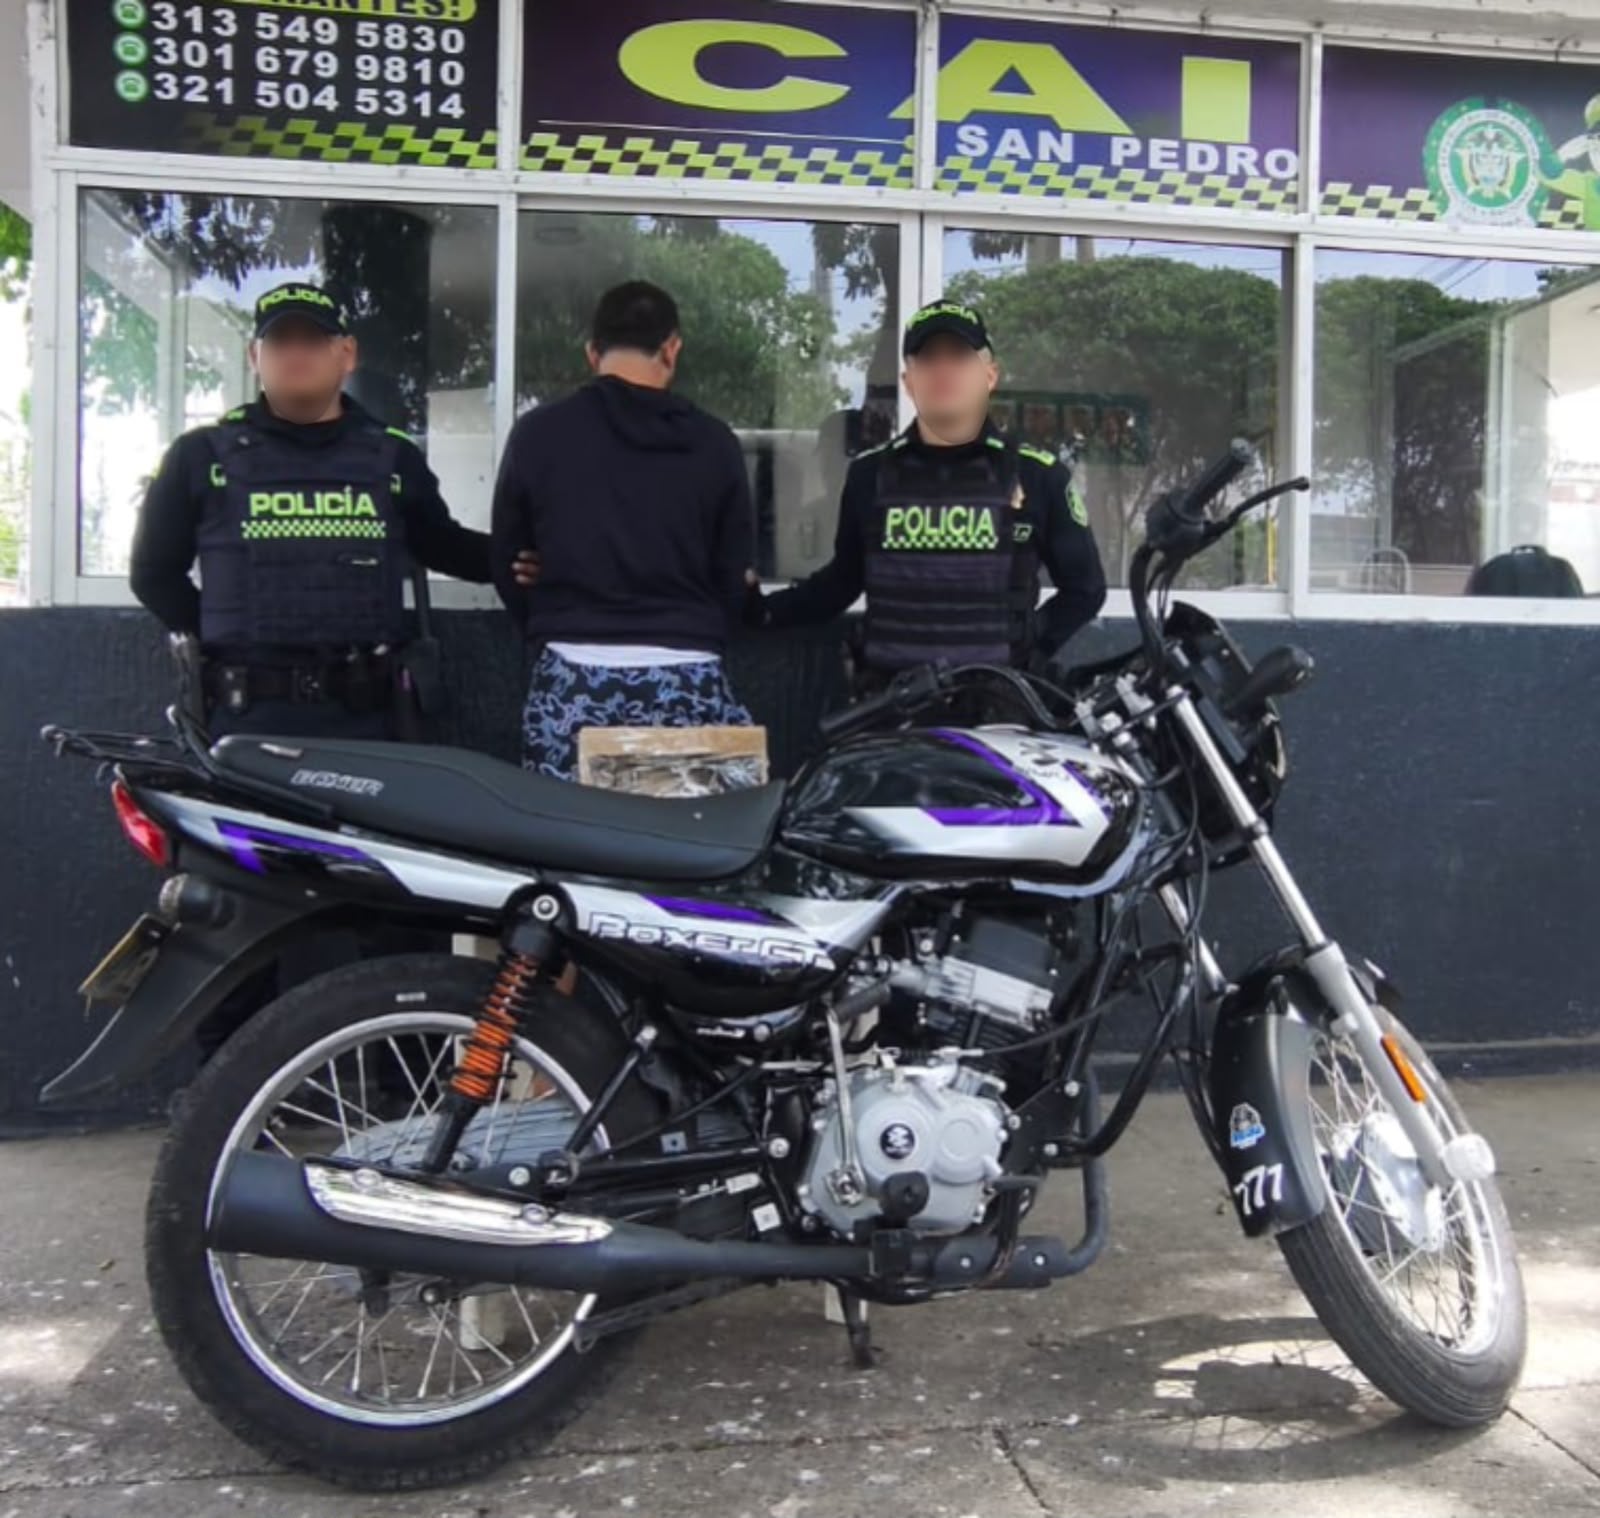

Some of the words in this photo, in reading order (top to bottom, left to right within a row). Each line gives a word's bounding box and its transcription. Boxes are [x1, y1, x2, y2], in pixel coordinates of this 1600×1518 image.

[152, 2, 237, 36] 313
[255, 12, 339, 45] 549
[355, 21, 465, 54] 5830
[153, 37, 235, 71] 301
[255, 45, 339, 79] 679
[355, 53, 465, 87] 9810
[618, 19, 1252, 144] CAI
[154, 73, 236, 104] 321
[255, 82, 340, 111] 504
[355, 89, 465, 119] 5314
[956, 125, 1074, 163] SAN
[1111, 135, 1300, 180] PEDRO
[885, 505, 996, 542] POLICIA
